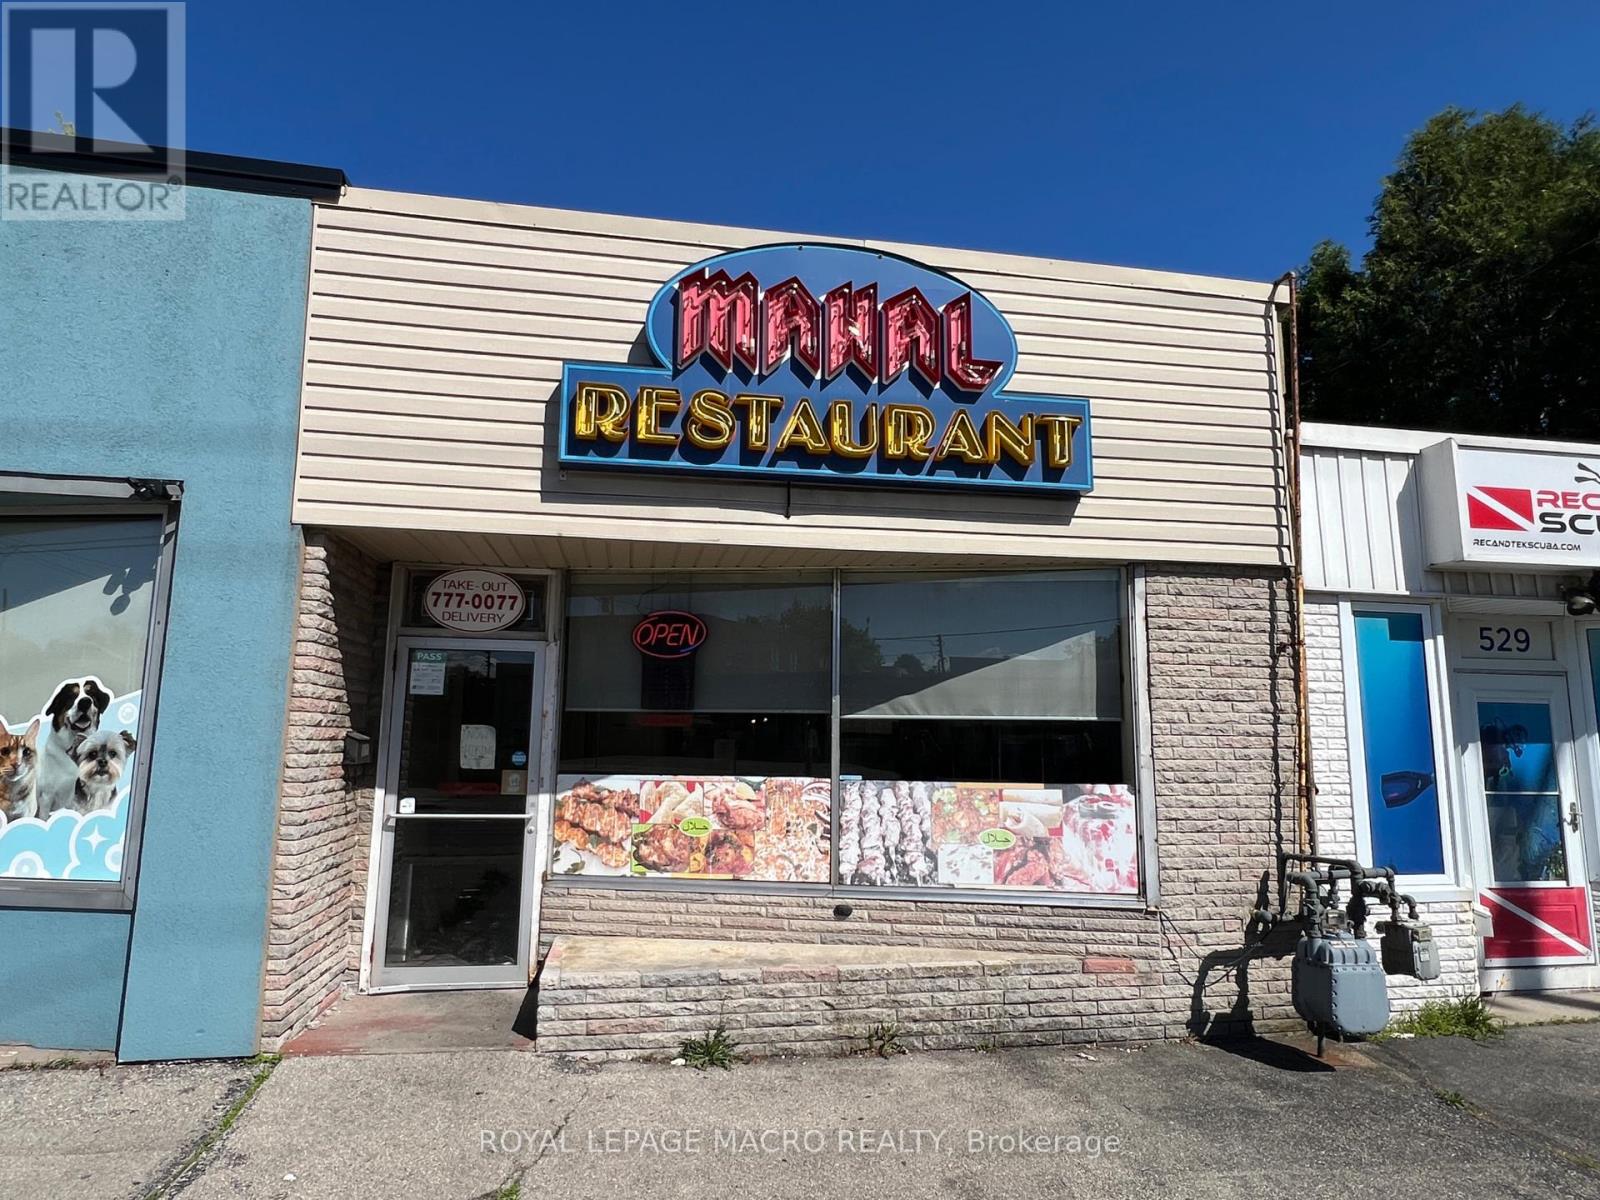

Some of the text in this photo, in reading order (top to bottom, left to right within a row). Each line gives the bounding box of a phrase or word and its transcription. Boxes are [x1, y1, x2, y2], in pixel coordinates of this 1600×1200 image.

[677, 267, 1003, 392] MAHAL
[575, 382, 1083, 468] RESTAURANT
[1539, 512, 1600, 535] SC
[1473, 538, 1581, 551] RECANDTEKSCUBA.COM
[432, 592, 518, 610] 777-0077
[442, 611, 505, 623] DELIVERY
[637, 624, 699, 646] OPEN
[1479, 627, 1530, 652] 529
[417, 652, 442, 661] PASS
